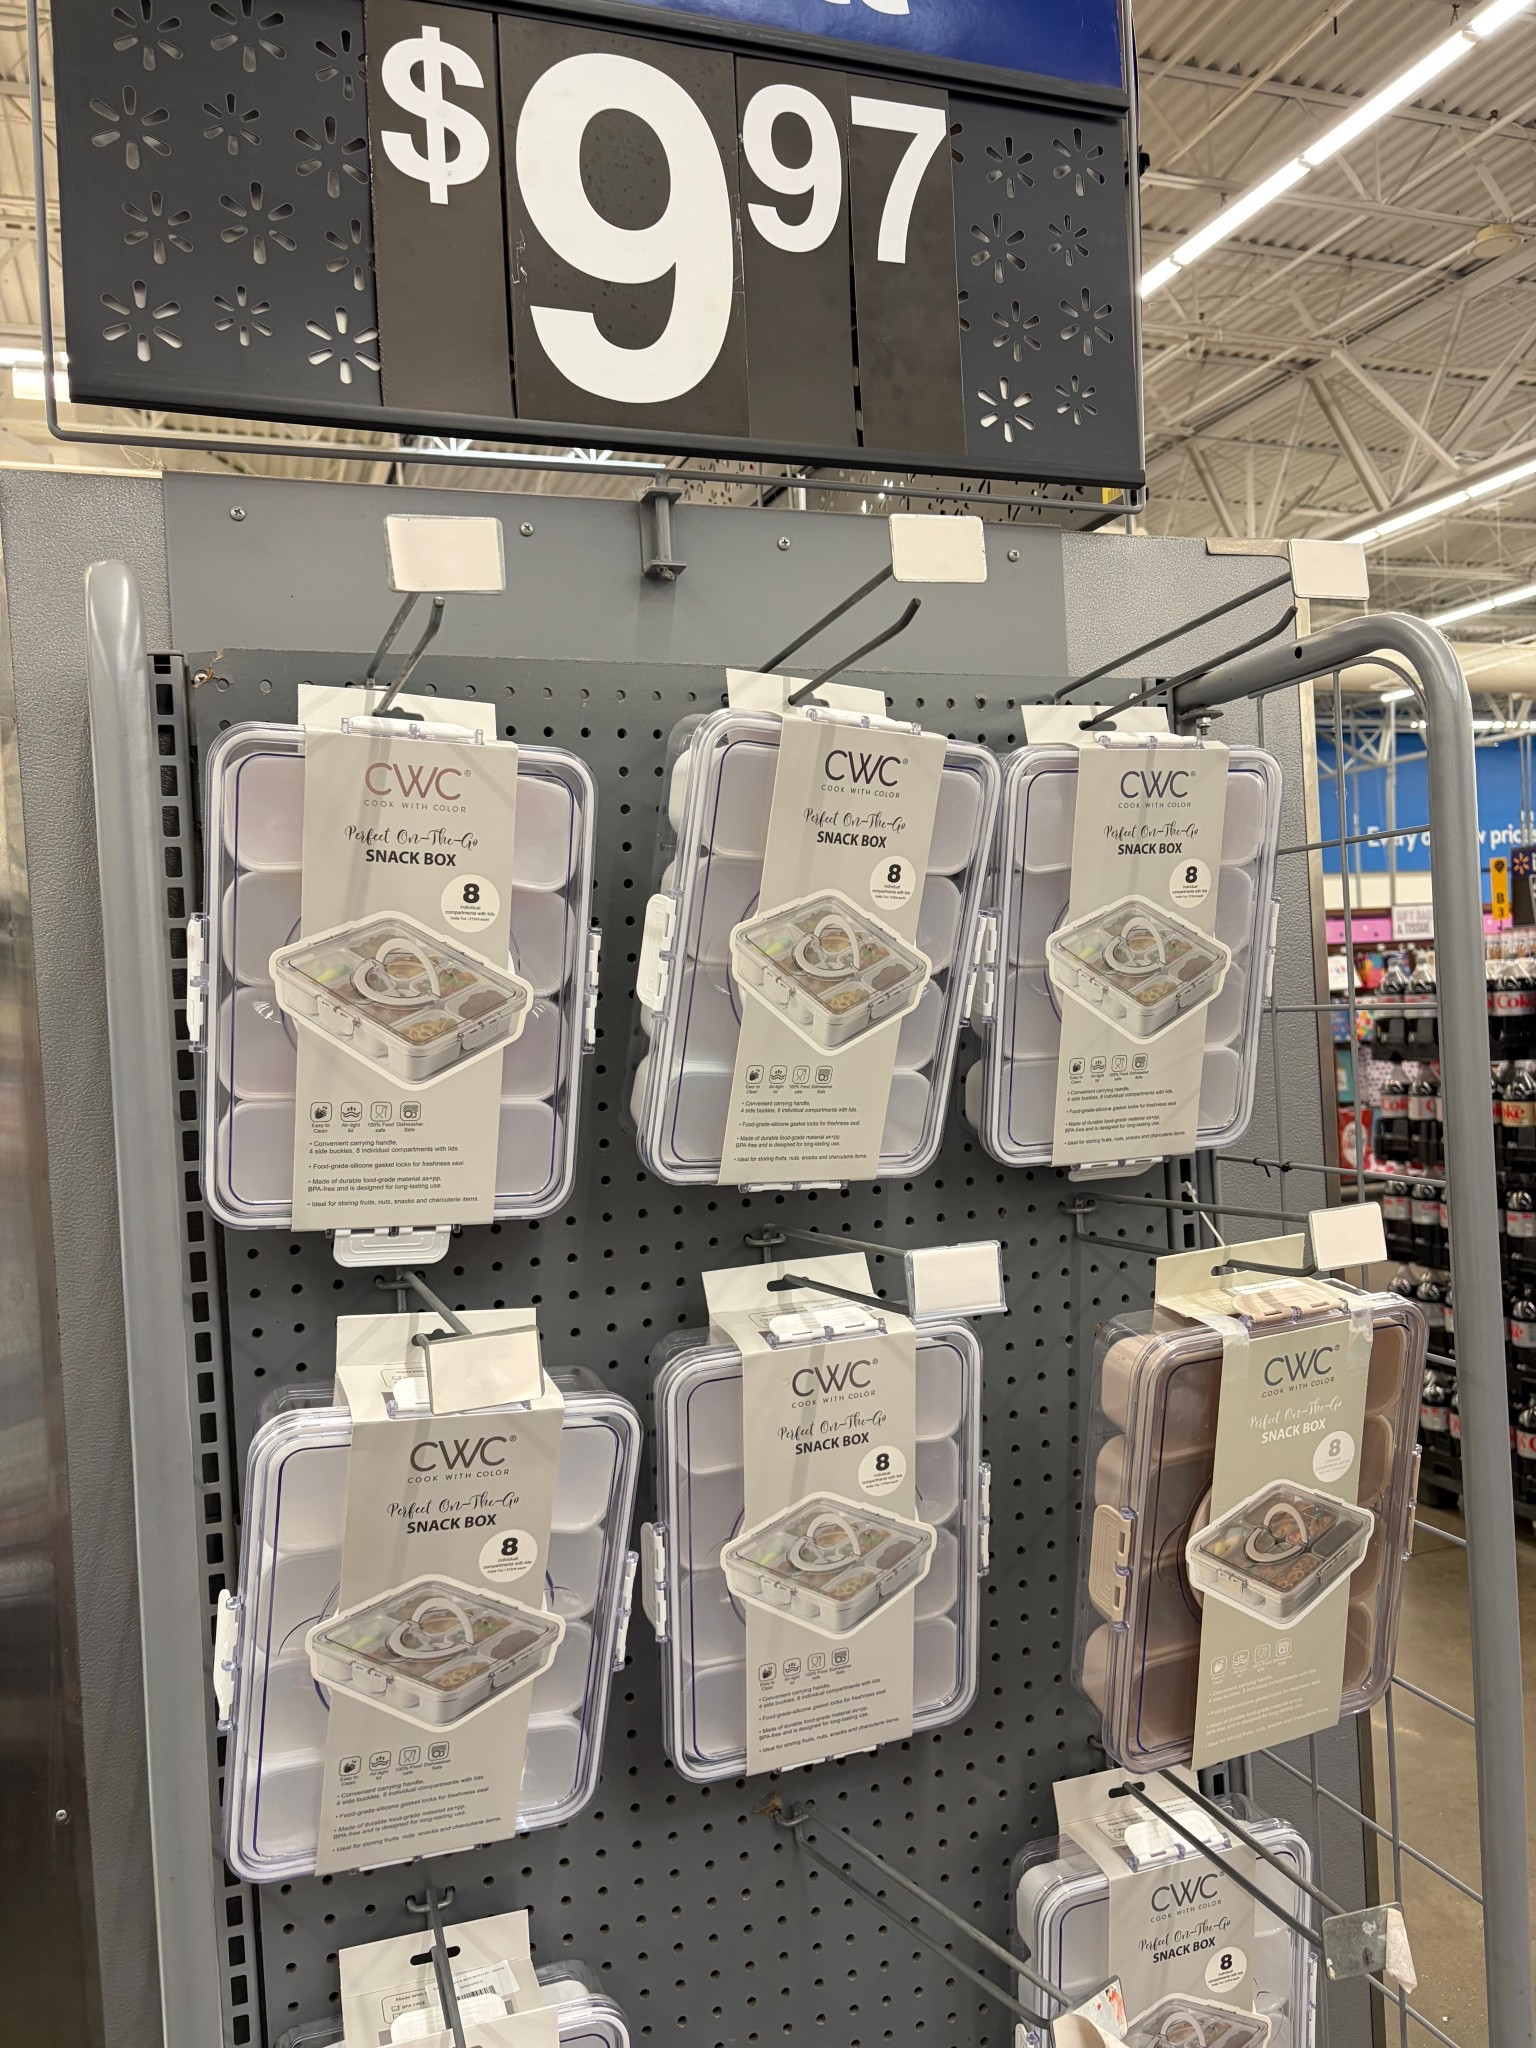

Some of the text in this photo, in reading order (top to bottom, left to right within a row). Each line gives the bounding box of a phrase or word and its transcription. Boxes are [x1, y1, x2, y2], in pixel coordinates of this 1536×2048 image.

[821, 785, 901, 799] COOK WITH COLOR
[364, 799, 467, 813] COOK WITH COLOR
[803, 807, 839, 826] Perfect
[344, 824, 391, 846] Perfect
[816, 831, 887, 848] SNACK BOX
[1104, 825, 1137, 842] Perfect
[365, 849, 456, 867] SNACK BOX
[1117, 843, 1182, 855] SNACK BOX
[887, 864, 902, 883] 8
[1185, 866, 1198, 884] 8
[463, 883, 480, 903] 8
[1262, 1377, 1335, 1398] COOK WITH COLOR
[792, 1390, 876, 1409] COOK WITH COLOR
[777, 1422, 815, 1441] Perfect
[1261, 1418, 1326, 1444] SNACK BOX
[796, 1432, 870, 1455] SNACK BOX
[1328, 1439, 1341, 1457] 8
[875, 1453, 890, 1471] 8
[407, 1469, 510, 1484] COOK WITH COLOR
[387, 1499, 432, 1519] Perfect
[406, 1514, 497, 1534] SNACK BOX
[501, 1537, 518, 1556] 8
[1150, 1899, 1222, 1923] COOK WITH COLOR
[1138, 1932, 1170, 1952] Perfect
[1153, 1936, 1216, 1964] SNACK BOX
[1220, 1954, 1233, 1970] 8
